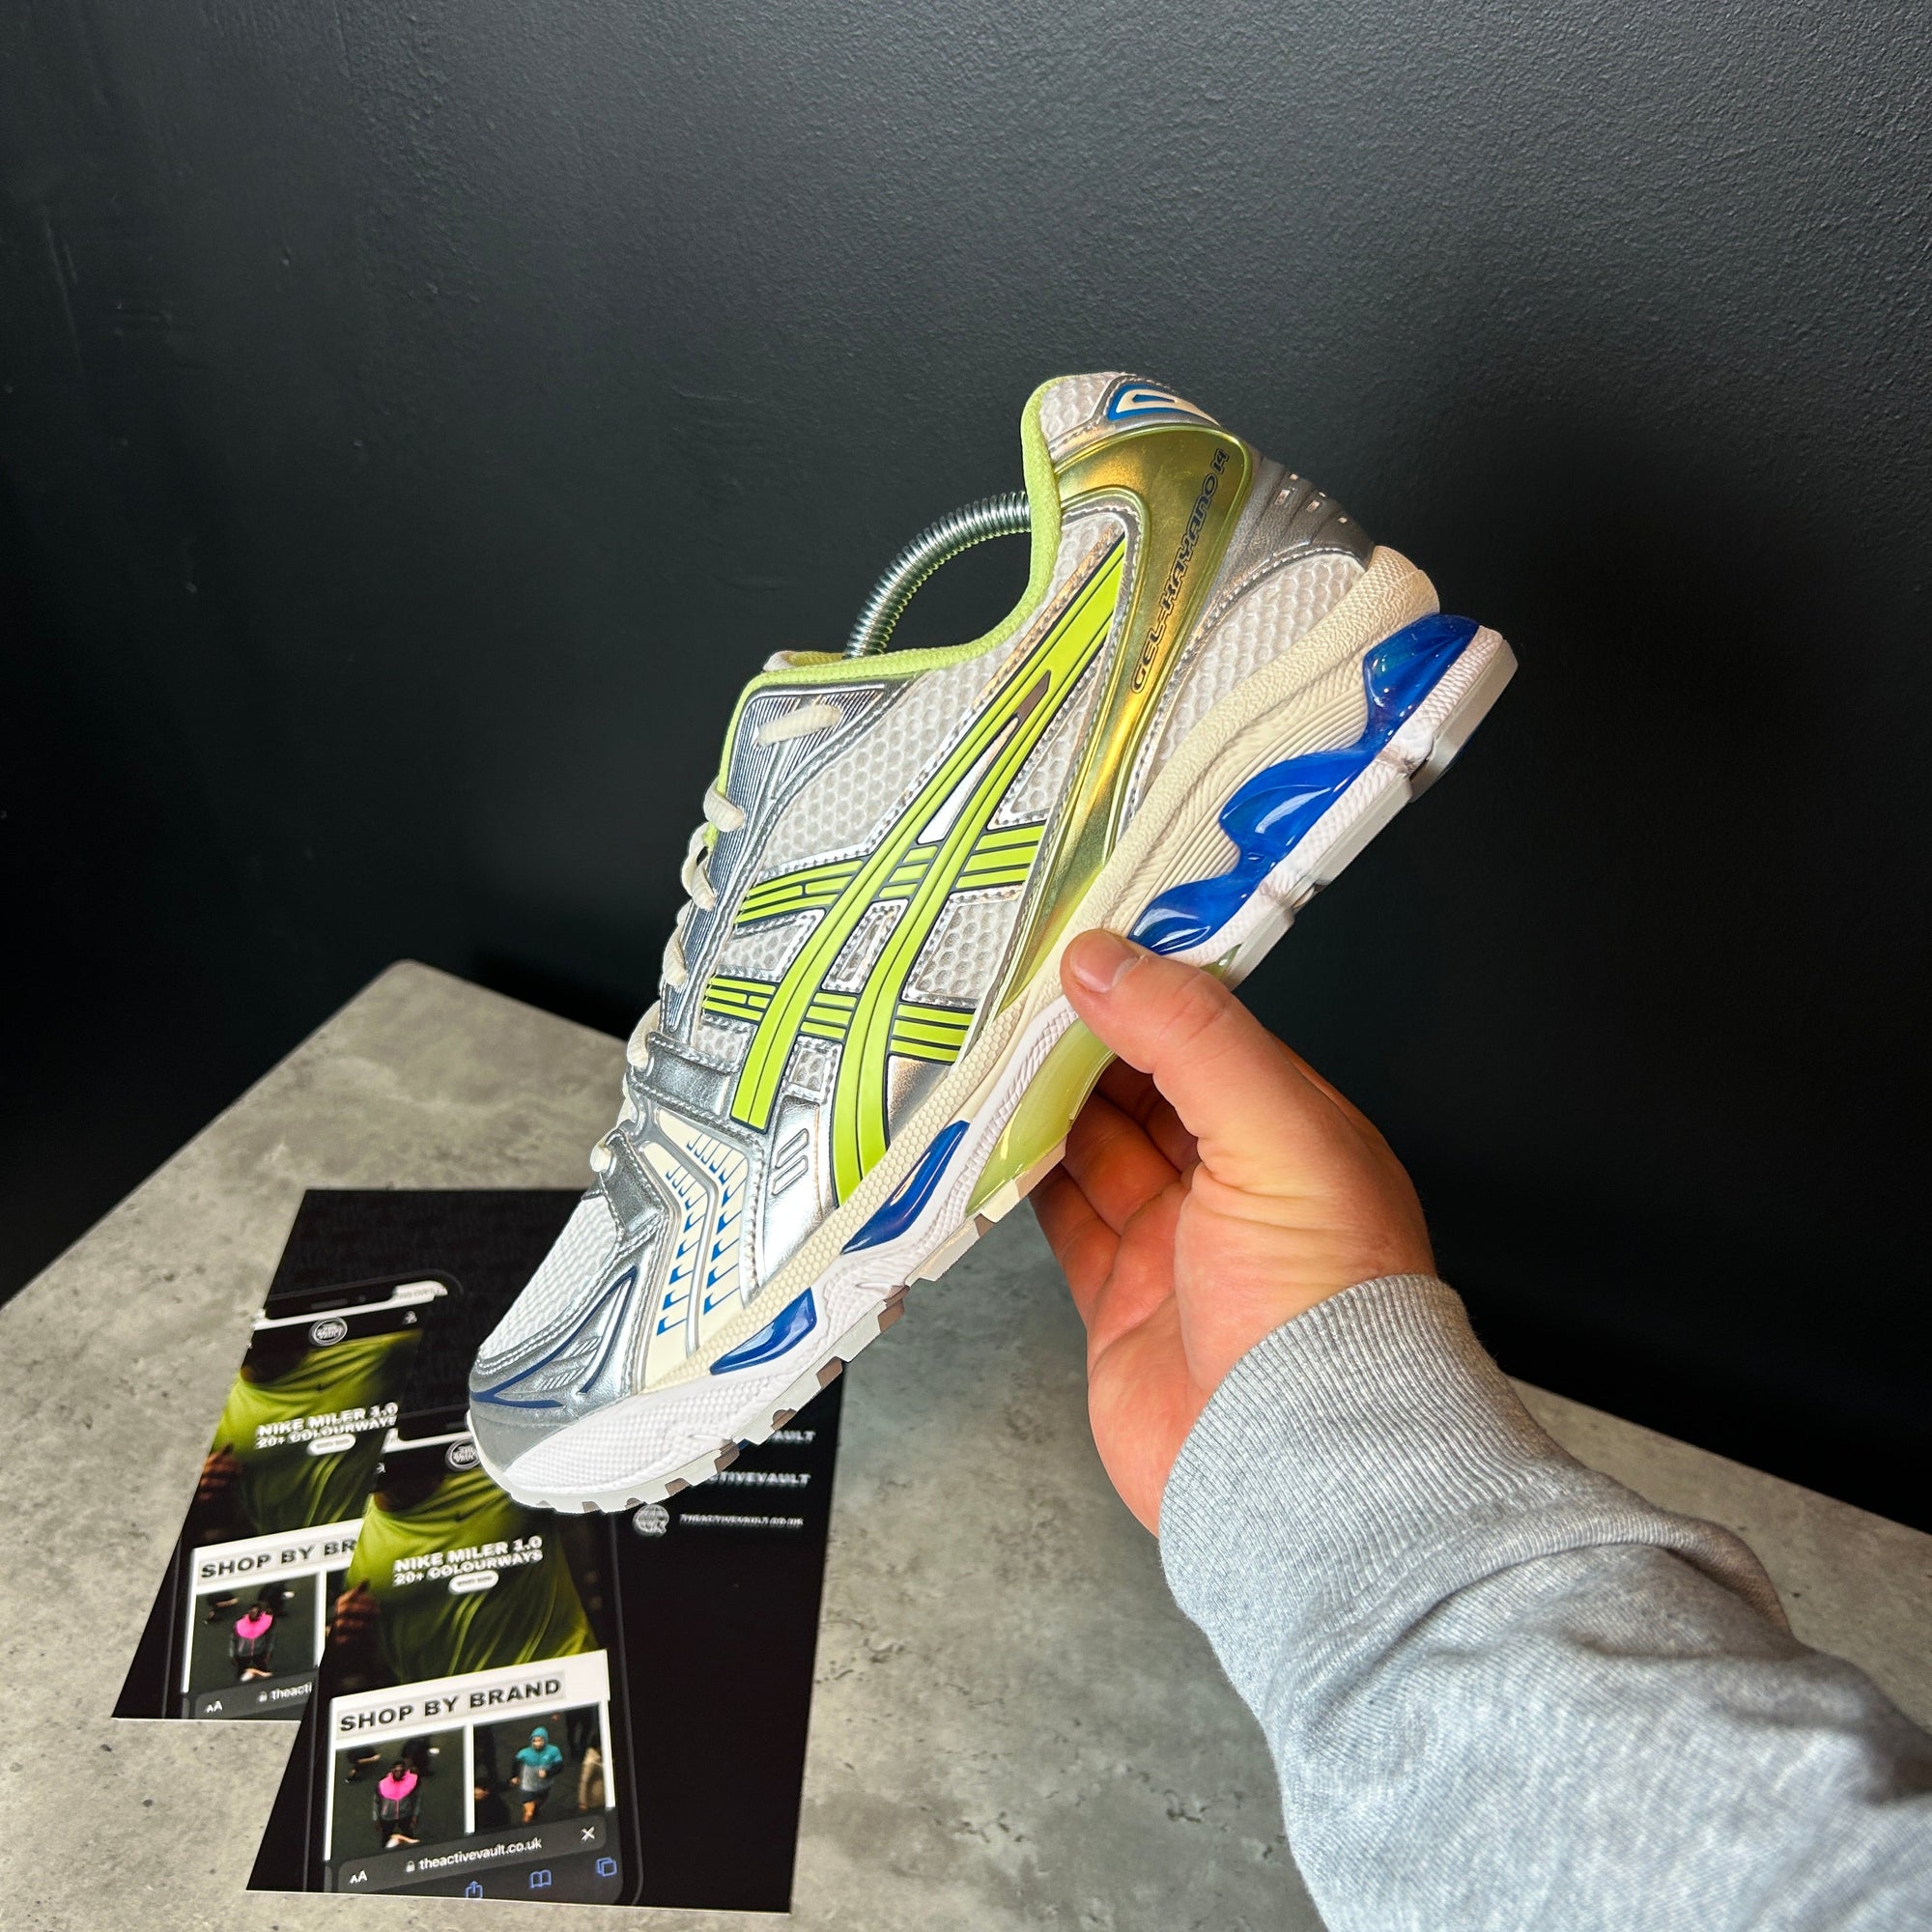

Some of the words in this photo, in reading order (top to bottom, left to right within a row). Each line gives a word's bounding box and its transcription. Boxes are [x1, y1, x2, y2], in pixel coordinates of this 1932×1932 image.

[256, 1417, 304, 1437] NIKE
[306, 1407, 366, 1429] MILER
[370, 1402, 399, 1417] 1.0
[255, 1435, 286, 1449] 20+
[201, 1553, 272, 1578] SHOP
[280, 1545, 315, 1564] BY
[392, 1571, 425, 1587] 20+
[426, 1548, 544, 1581] COLOURWAYS
[393, 1551, 444, 1574] NIKE
[446, 1541, 509, 1565] MILER
[512, 1535, 543, 1552] 1.0
[339, 1704, 414, 1732] SHOP
[424, 1694, 460, 1718] BY
[469, 1678, 562, 1709] BRAND
[418, 1836, 543, 1871] theactivevault.co.uk
